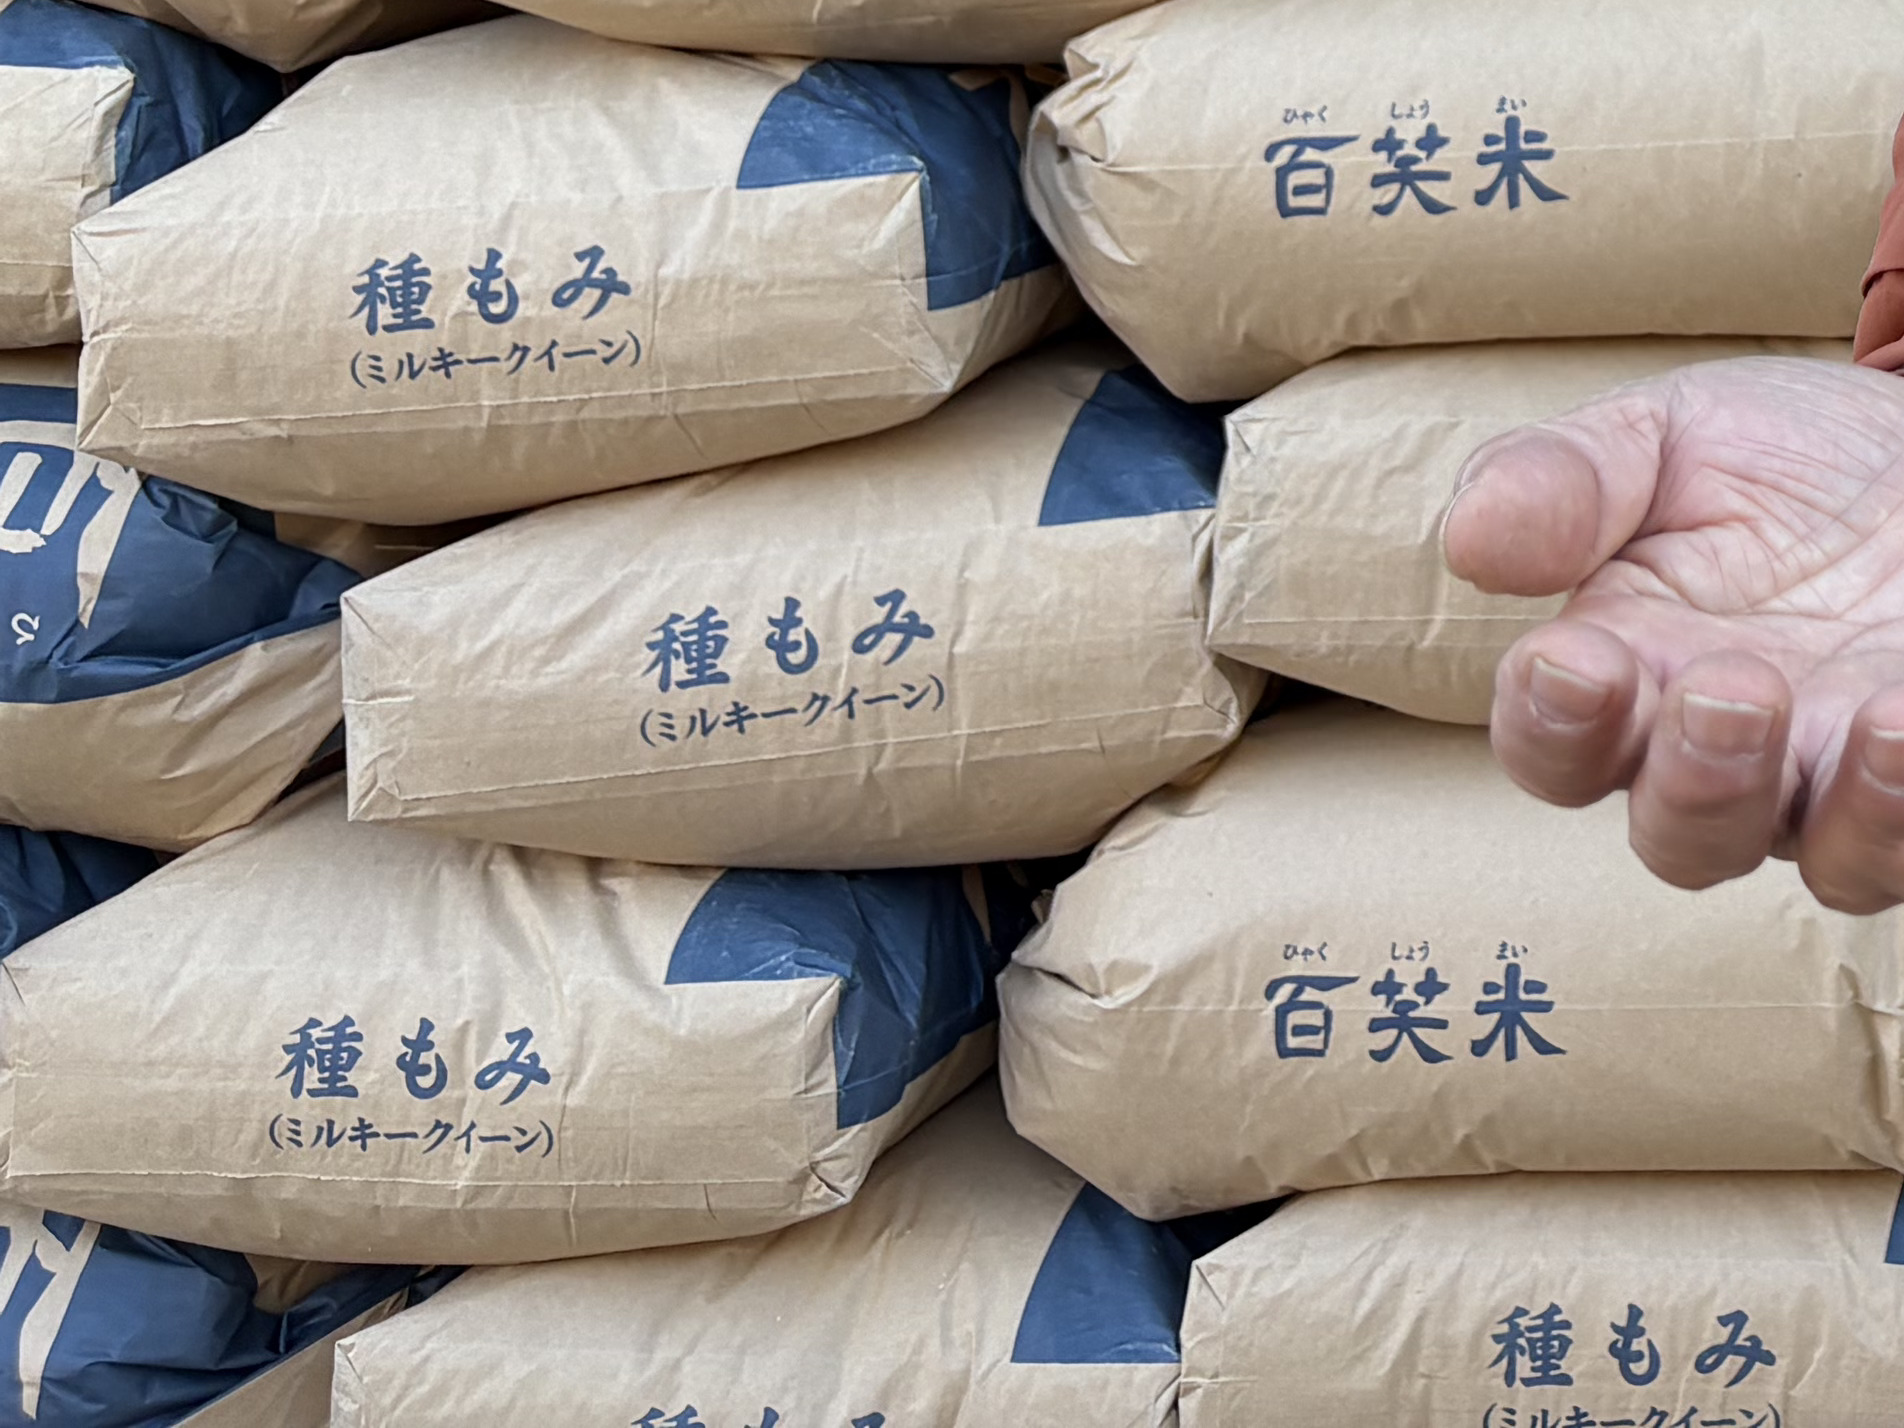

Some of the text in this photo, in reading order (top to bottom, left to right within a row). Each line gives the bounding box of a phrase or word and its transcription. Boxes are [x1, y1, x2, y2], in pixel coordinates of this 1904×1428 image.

[1264, 116, 1569, 219] 百笑米
[350, 245, 631, 336] 種もみ
[643, 589, 935, 693] 種もみ
[276, 1015, 551, 1105] 種もみ
[1264, 963, 1567, 1064] 百笑米
[1488, 1303, 1776, 1388] 種もみ
